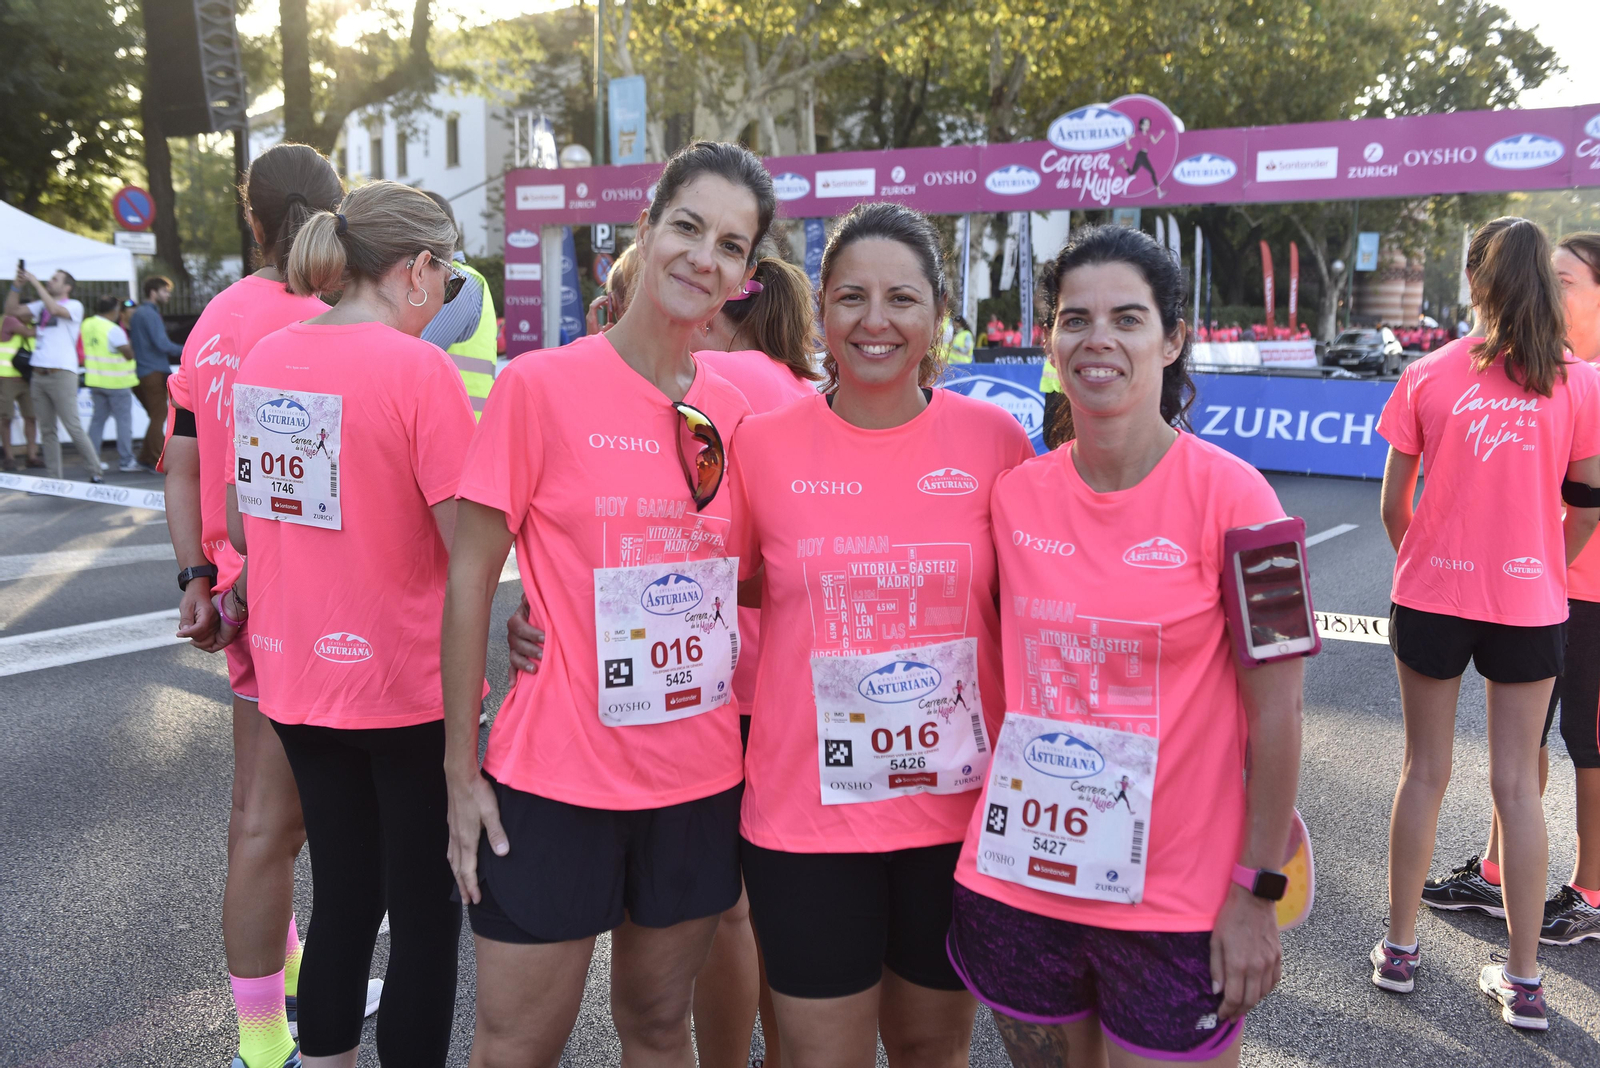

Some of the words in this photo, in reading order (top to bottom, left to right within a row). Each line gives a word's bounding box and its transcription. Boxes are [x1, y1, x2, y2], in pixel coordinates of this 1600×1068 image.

[1055, 126, 1126, 142] ASTURIANA
[1040, 149, 1115, 174] Carrera
[1403, 146, 1477, 168] OYSHO
[923, 168, 977, 187] OYSHO
[1347, 164, 1398, 179] ZURICH
[601, 187, 643, 202] OYSHO
[880, 184, 916, 196] ZURICH
[1056, 174, 1071, 189] de
[1071, 172, 1082, 188] la
[1078, 169, 1136, 206] Mujer
[596, 224, 610, 248] P
[1452, 383, 1542, 415] Carrera
[260, 409, 306, 427] ASTURIANA
[1200, 404, 1375, 445] ZURICH
[1515, 416, 1525, 427] de
[1528, 416, 1537, 427] la
[588, 433, 660, 454] OYSHO
[1465, 414, 1524, 462] Mujer
[261, 451, 304, 479] 016
[271, 481, 294, 494] 1746
[791, 479, 863, 495] OYSHO
[922, 479, 974, 491] ASTURIANA
[240, 494, 262, 506] OYSHO
[595, 496, 628, 517] HOY
[636, 497, 687, 519] GANAN
[313, 513, 333, 521] ZURICH
[648, 527, 682, 539] VITORIA
[621, 536, 633, 549] SE
[664, 540, 699, 552] MADRID
[797, 537, 825, 558] HOY
[833, 535, 890, 554] GANAN
[1012, 530, 1076, 556] OYSHO
[1127, 549, 1182, 564] ASTURIANA
[1430, 556, 1474, 572] OYSHO
[851, 562, 897, 576] VITORIA
[909, 560, 955, 574] GASTEIZ
[821, 574, 833, 587] SE
[877, 574, 924, 589] MADRID
[646, 590, 699, 608] ASTURIANA
[823, 587, 833, 599] VI
[825, 598, 836, 611] LL
[854, 602, 867, 614] VA
[886, 602, 896, 611] KM
[1031, 598, 1076, 623] GANAN
[685, 612, 708, 622] Carrera
[856, 614, 873, 627] LEN
[856, 627, 872, 640] CIA
[882, 623, 906, 640] LAS
[318, 641, 370, 656] ASTURIANA
[1040, 631, 1079, 648] VITORIA
[1090, 637, 1139, 654] GASTEIZ
[650, 635, 703, 669] 016
[1061, 647, 1106, 664] MADRID
[665, 670, 693, 687] 5425
[865, 676, 936, 696] ASTURIANA
[675, 694, 697, 704] Santander
[918, 697, 949, 710] Carrera
[1066, 697, 1088, 715] LAS
[608, 701, 651, 714] OYSHO
[871, 721, 939, 753] 016
[890, 757, 926, 770] 5426
[1027, 745, 1096, 772] ASTURIANA
[830, 781, 872, 791] OYSHO
[954, 775, 981, 786] ZURICH
[1070, 780, 1108, 797] Carrera
[1090, 795, 1117, 813] Mujer
[1022, 799, 1089, 837] 016
[1032, 837, 1067, 856] 5427
[984, 850, 1015, 867] OYSHO
[1040, 865, 1070, 878] Santander
[1095, 883, 1127, 894] ZURICH
